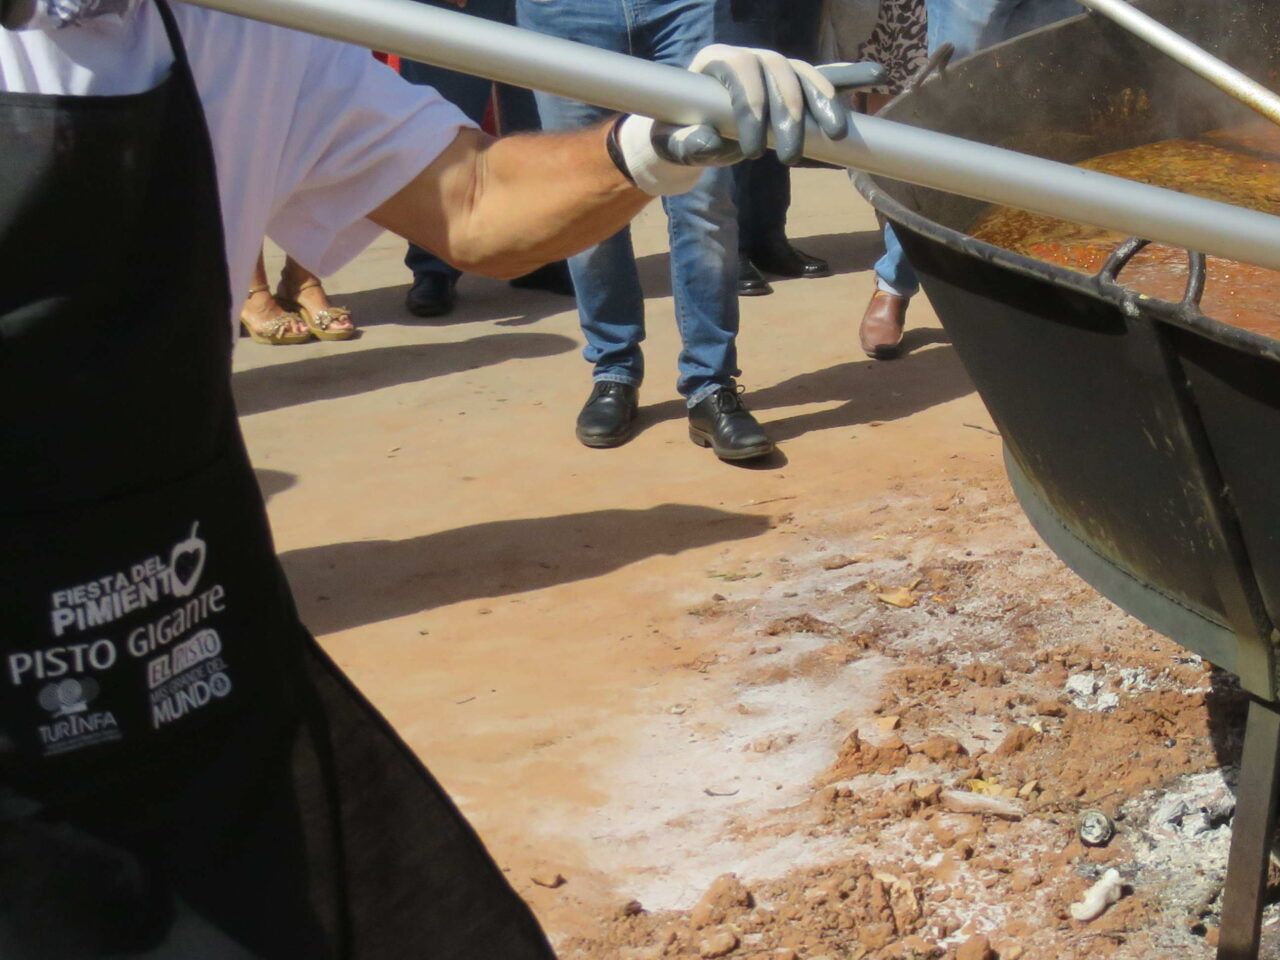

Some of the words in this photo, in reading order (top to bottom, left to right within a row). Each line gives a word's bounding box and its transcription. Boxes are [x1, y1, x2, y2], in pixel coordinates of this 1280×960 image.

[51, 536, 206, 637] PIMIENTO
[52, 572, 129, 608] FIESTA
[131, 555, 166, 582] DEL
[7, 639, 117, 685] PISTO
[153, 672, 232, 729] MUNDO
